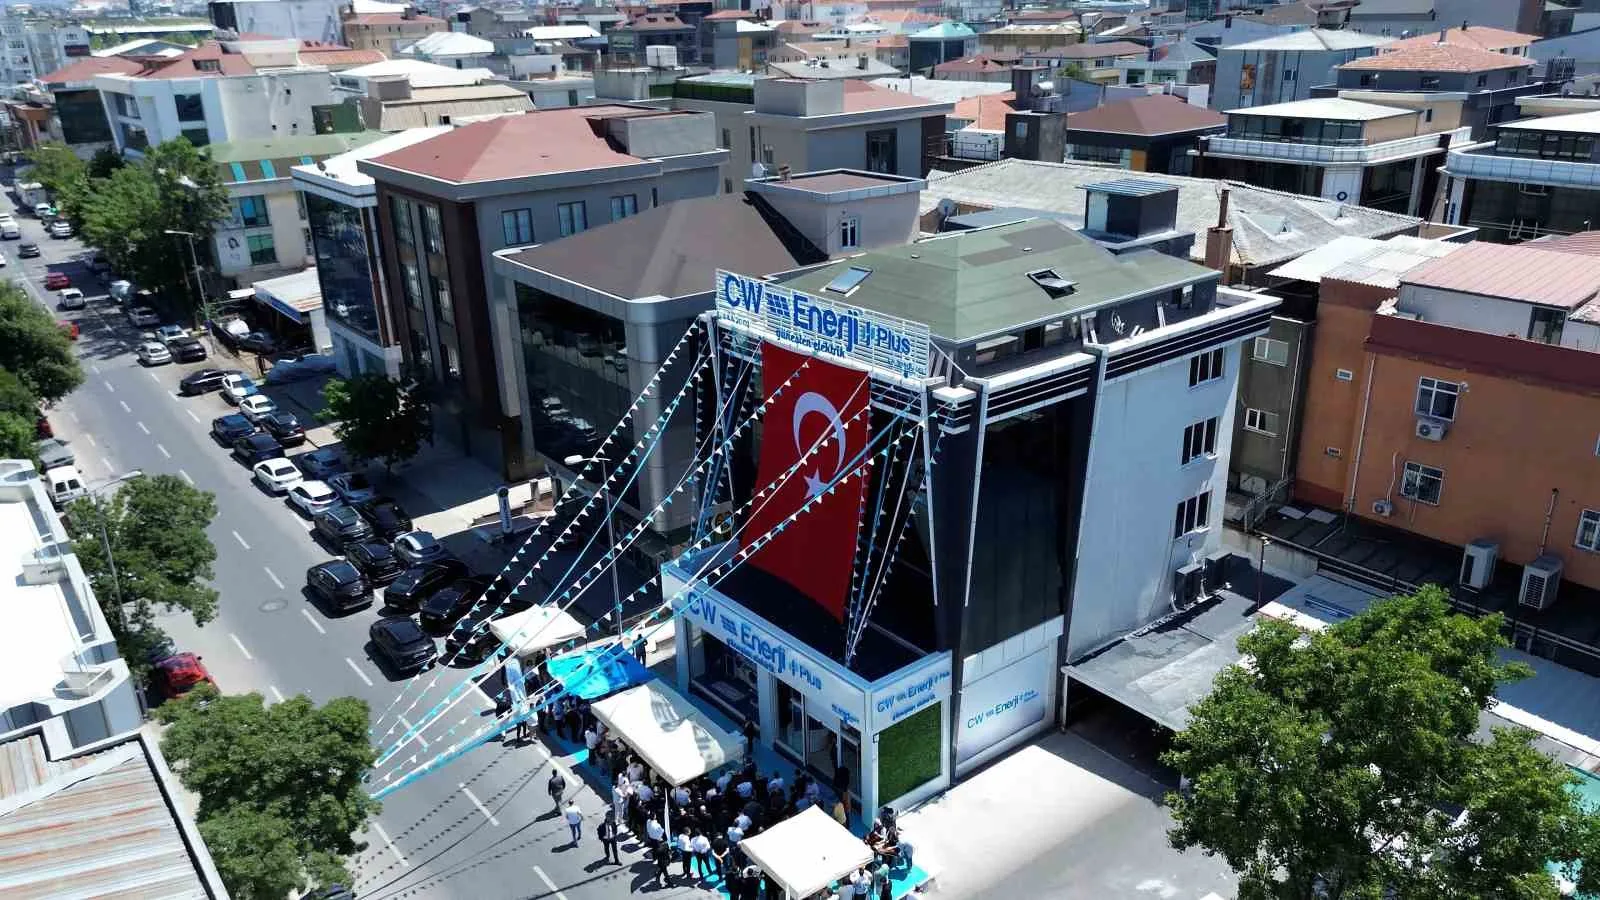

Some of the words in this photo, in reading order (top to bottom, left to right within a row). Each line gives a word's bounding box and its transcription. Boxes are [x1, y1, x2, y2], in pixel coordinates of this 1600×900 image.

[725, 275, 764, 314] CW
[793, 295, 859, 352] Enerji
[877, 326, 911, 356] Plus
[687, 591, 717, 625] CW
[741, 622, 786, 674] Enerji
[877, 695, 896, 713] CW
[908, 678, 934, 698] Enerji
[967, 713, 984, 729] CW
[995, 694, 1020, 715] Enerji
